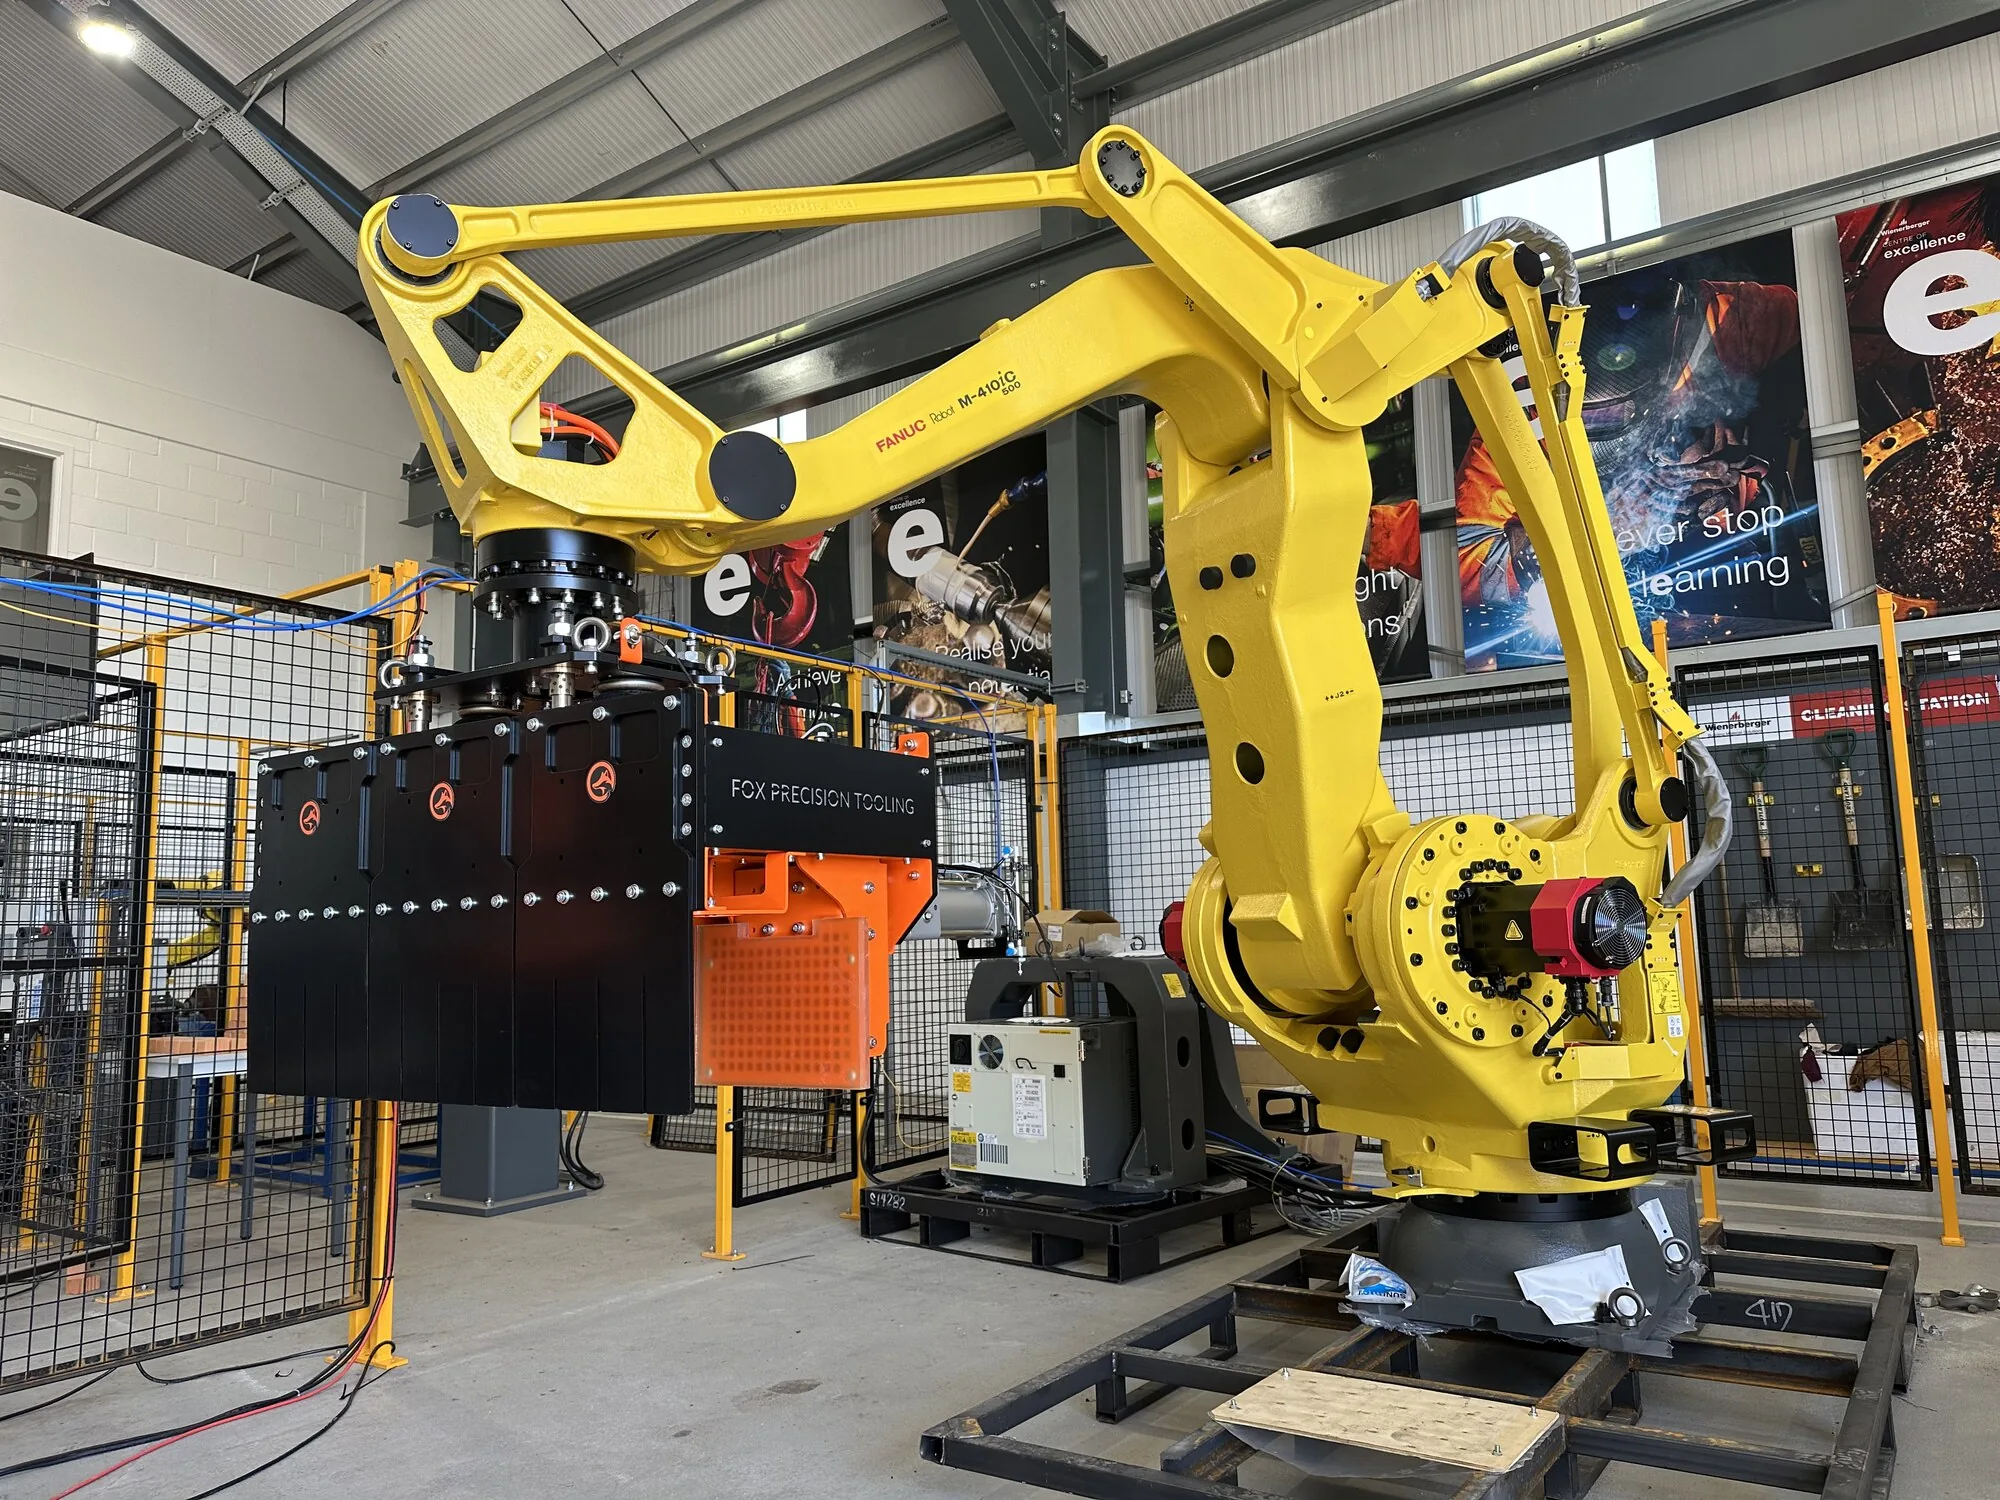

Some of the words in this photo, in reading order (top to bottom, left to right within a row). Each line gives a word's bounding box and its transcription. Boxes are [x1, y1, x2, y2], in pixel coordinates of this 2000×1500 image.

[1884, 232, 1966, 259] excellence
[1883, 249, 2000, 356] e
[1001, 380, 1021, 396] 500
[875, 419, 927, 453] FANUC
[929, 404, 956, 425] Robot
[888, 508, 945, 578] e
[1615, 519, 1690, 552] ever
[1703, 504, 1784, 538] stop
[704, 553, 751, 617] e
[1641, 555, 1790, 598] learning
[1010, 633, 1052, 659] your
[776, 669, 841, 692] Achieve
[1904, 692, 1990, 711] TATION
[1705, 719, 1772, 732] Wienerberger
[731, 779, 767, 801] FOX
[771, 783, 850, 809] PRECISION
[854, 793, 915, 815] TOOLING
